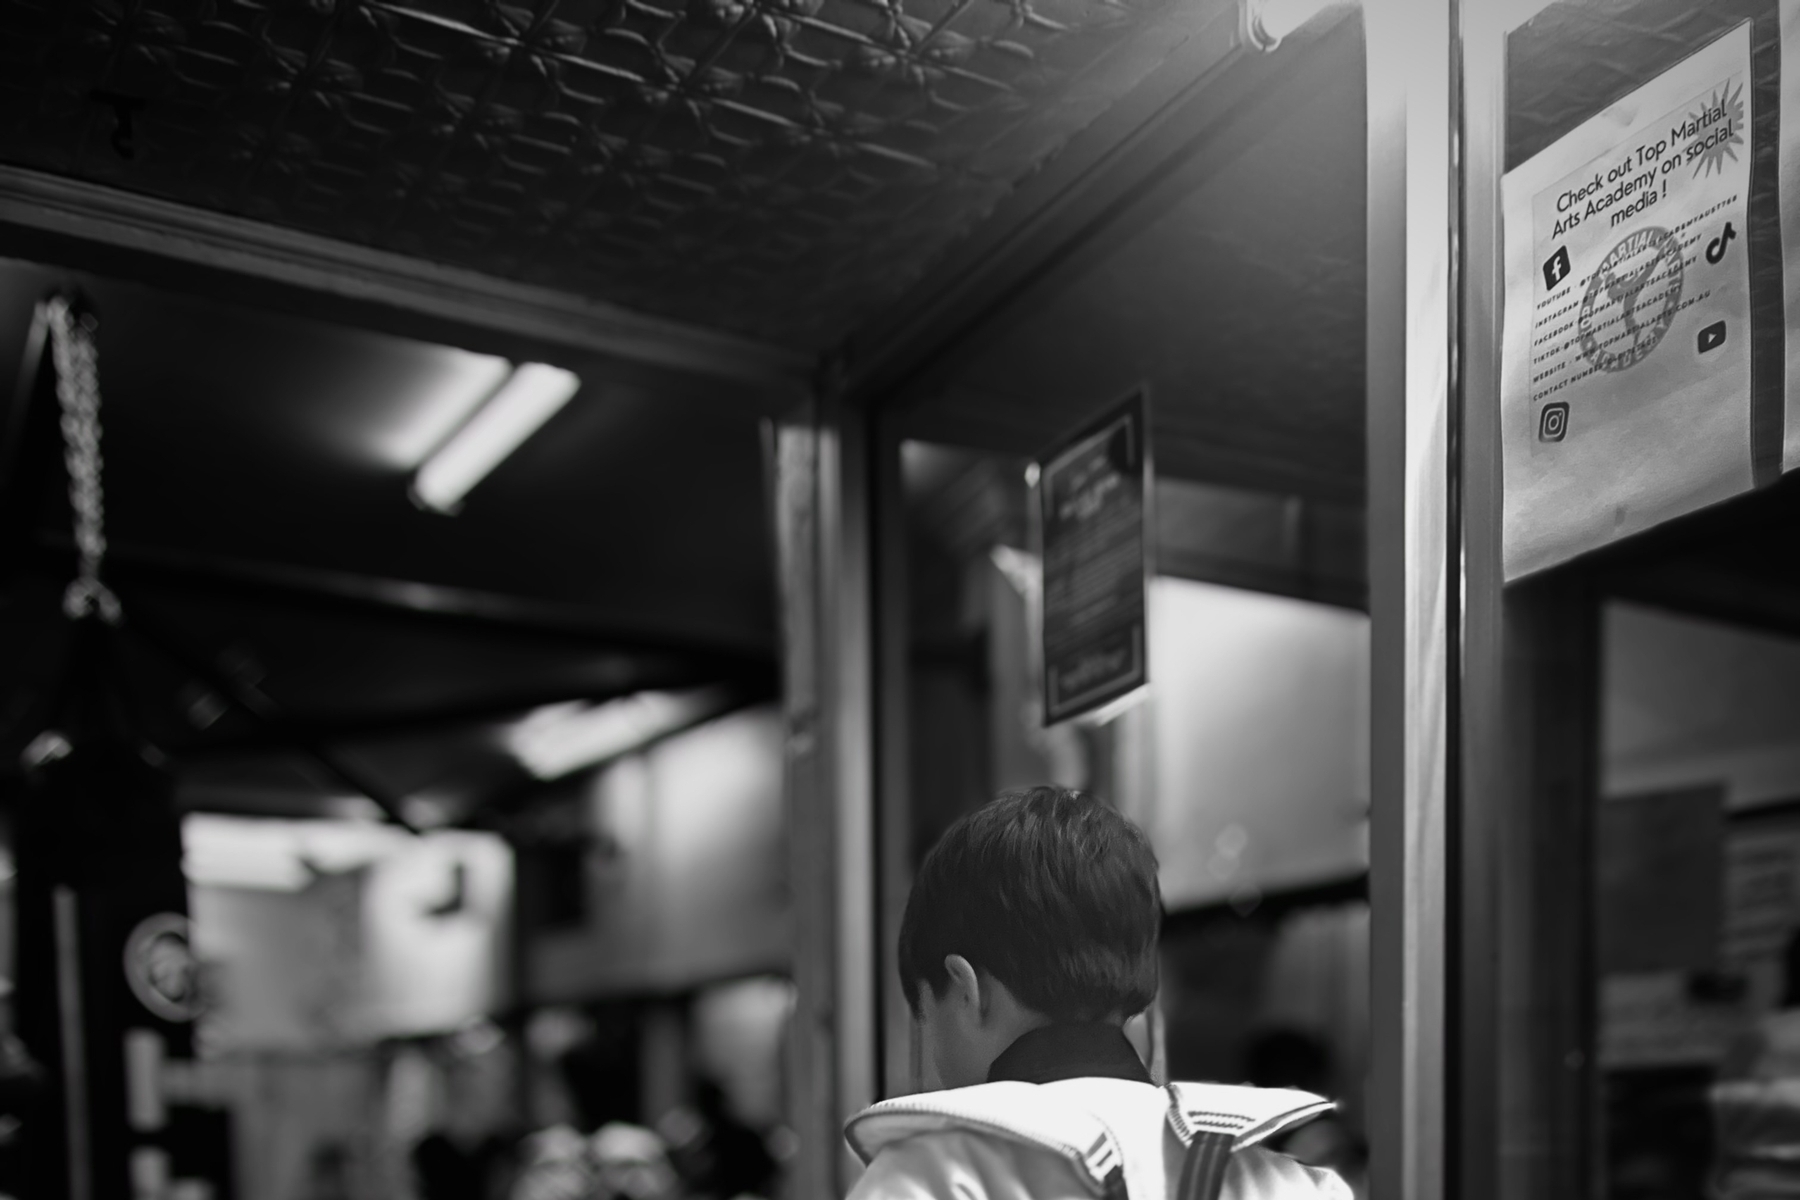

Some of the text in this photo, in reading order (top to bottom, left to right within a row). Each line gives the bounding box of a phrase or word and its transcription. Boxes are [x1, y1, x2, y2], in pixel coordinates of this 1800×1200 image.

[1557, 98, 1727, 213] Check out Top Martial
[1552, 119, 1734, 239] Arts Academy on social
[1611, 179, 1667, 228] media !
[1537, 286, 1571, 310] YOUTUBE
[1535, 299, 1579, 329] INSTAGRAM
[1534, 321, 1574, 346] FACEBOOK
[1533, 344, 1561, 365] TIKTOK
[1533, 362, 1567, 384] WEBSITE
[1533, 365, 1605, 401] CONTACT NUMBER
